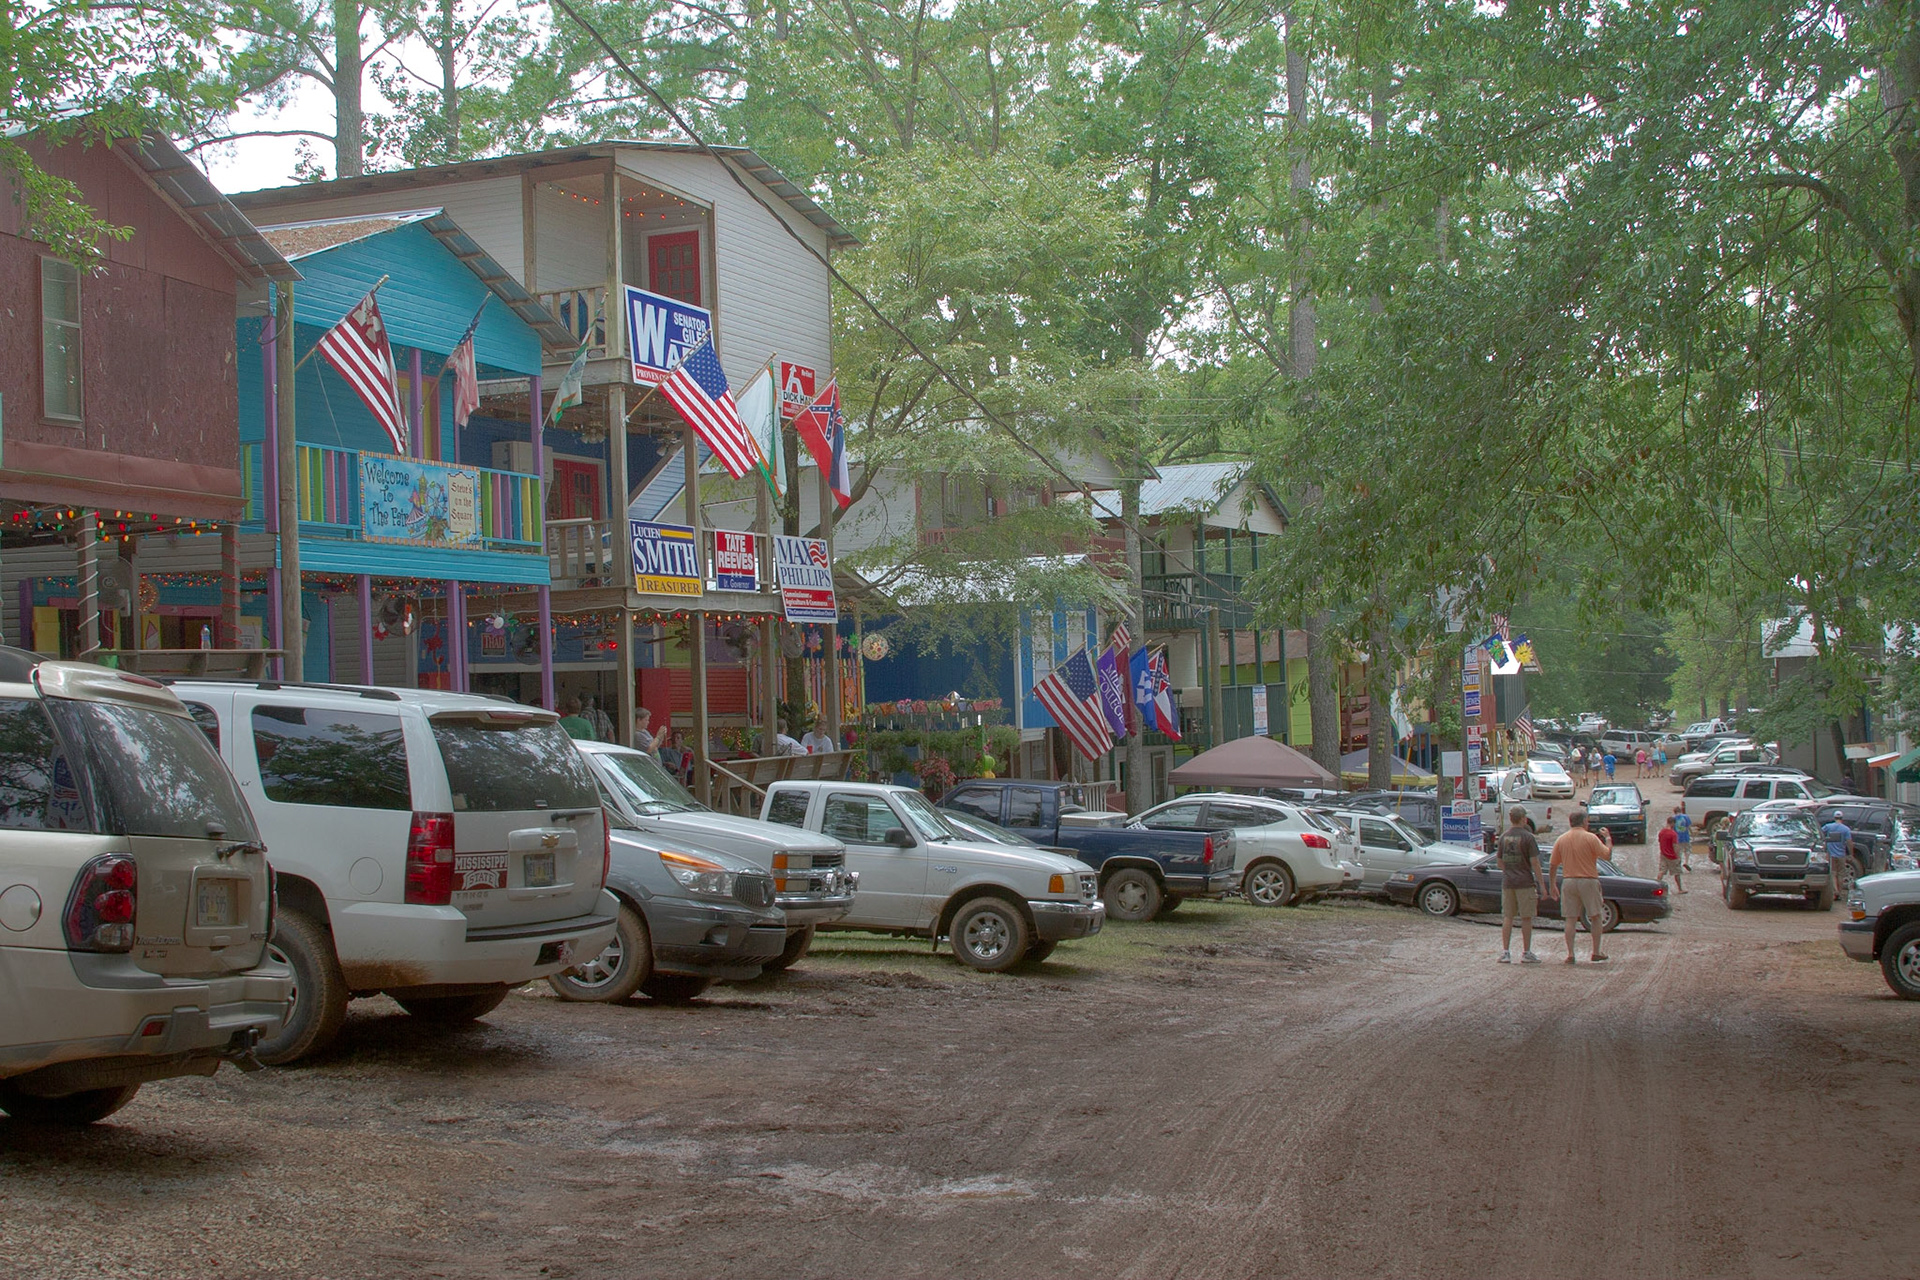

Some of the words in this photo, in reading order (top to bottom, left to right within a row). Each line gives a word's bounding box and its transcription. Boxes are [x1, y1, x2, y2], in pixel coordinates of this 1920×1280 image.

[673, 311, 707, 333] SENATOR
[636, 368, 660, 381] PROVEN
[783, 391, 799, 403] DICK
[364, 461, 410, 486] Welcome
[380, 485, 394, 503] To
[450, 482, 473, 495] Steve's
[454, 497, 462, 506] on
[463, 497, 472, 507] the
[369, 501, 389, 527] The
[391, 507, 409, 528] Fair
[450, 509, 473, 521] Square
[632, 523, 662, 539] LUCIEN
[724, 533, 747, 553] TATE
[633, 538, 699, 577] SMITH
[775, 537, 815, 566] MAX
[717, 551, 754, 571] REEVES
[730, 580, 750, 590] Governor
[779, 566, 832, 588] PHILLIPS
[638, 577, 701, 594] TREASURER
[483, 635, 505, 649] THAD
[1471, 778, 1476, 787] 5
[455, 856, 508, 871] MISSISSIPPI
[469, 872, 494, 885] STATE
